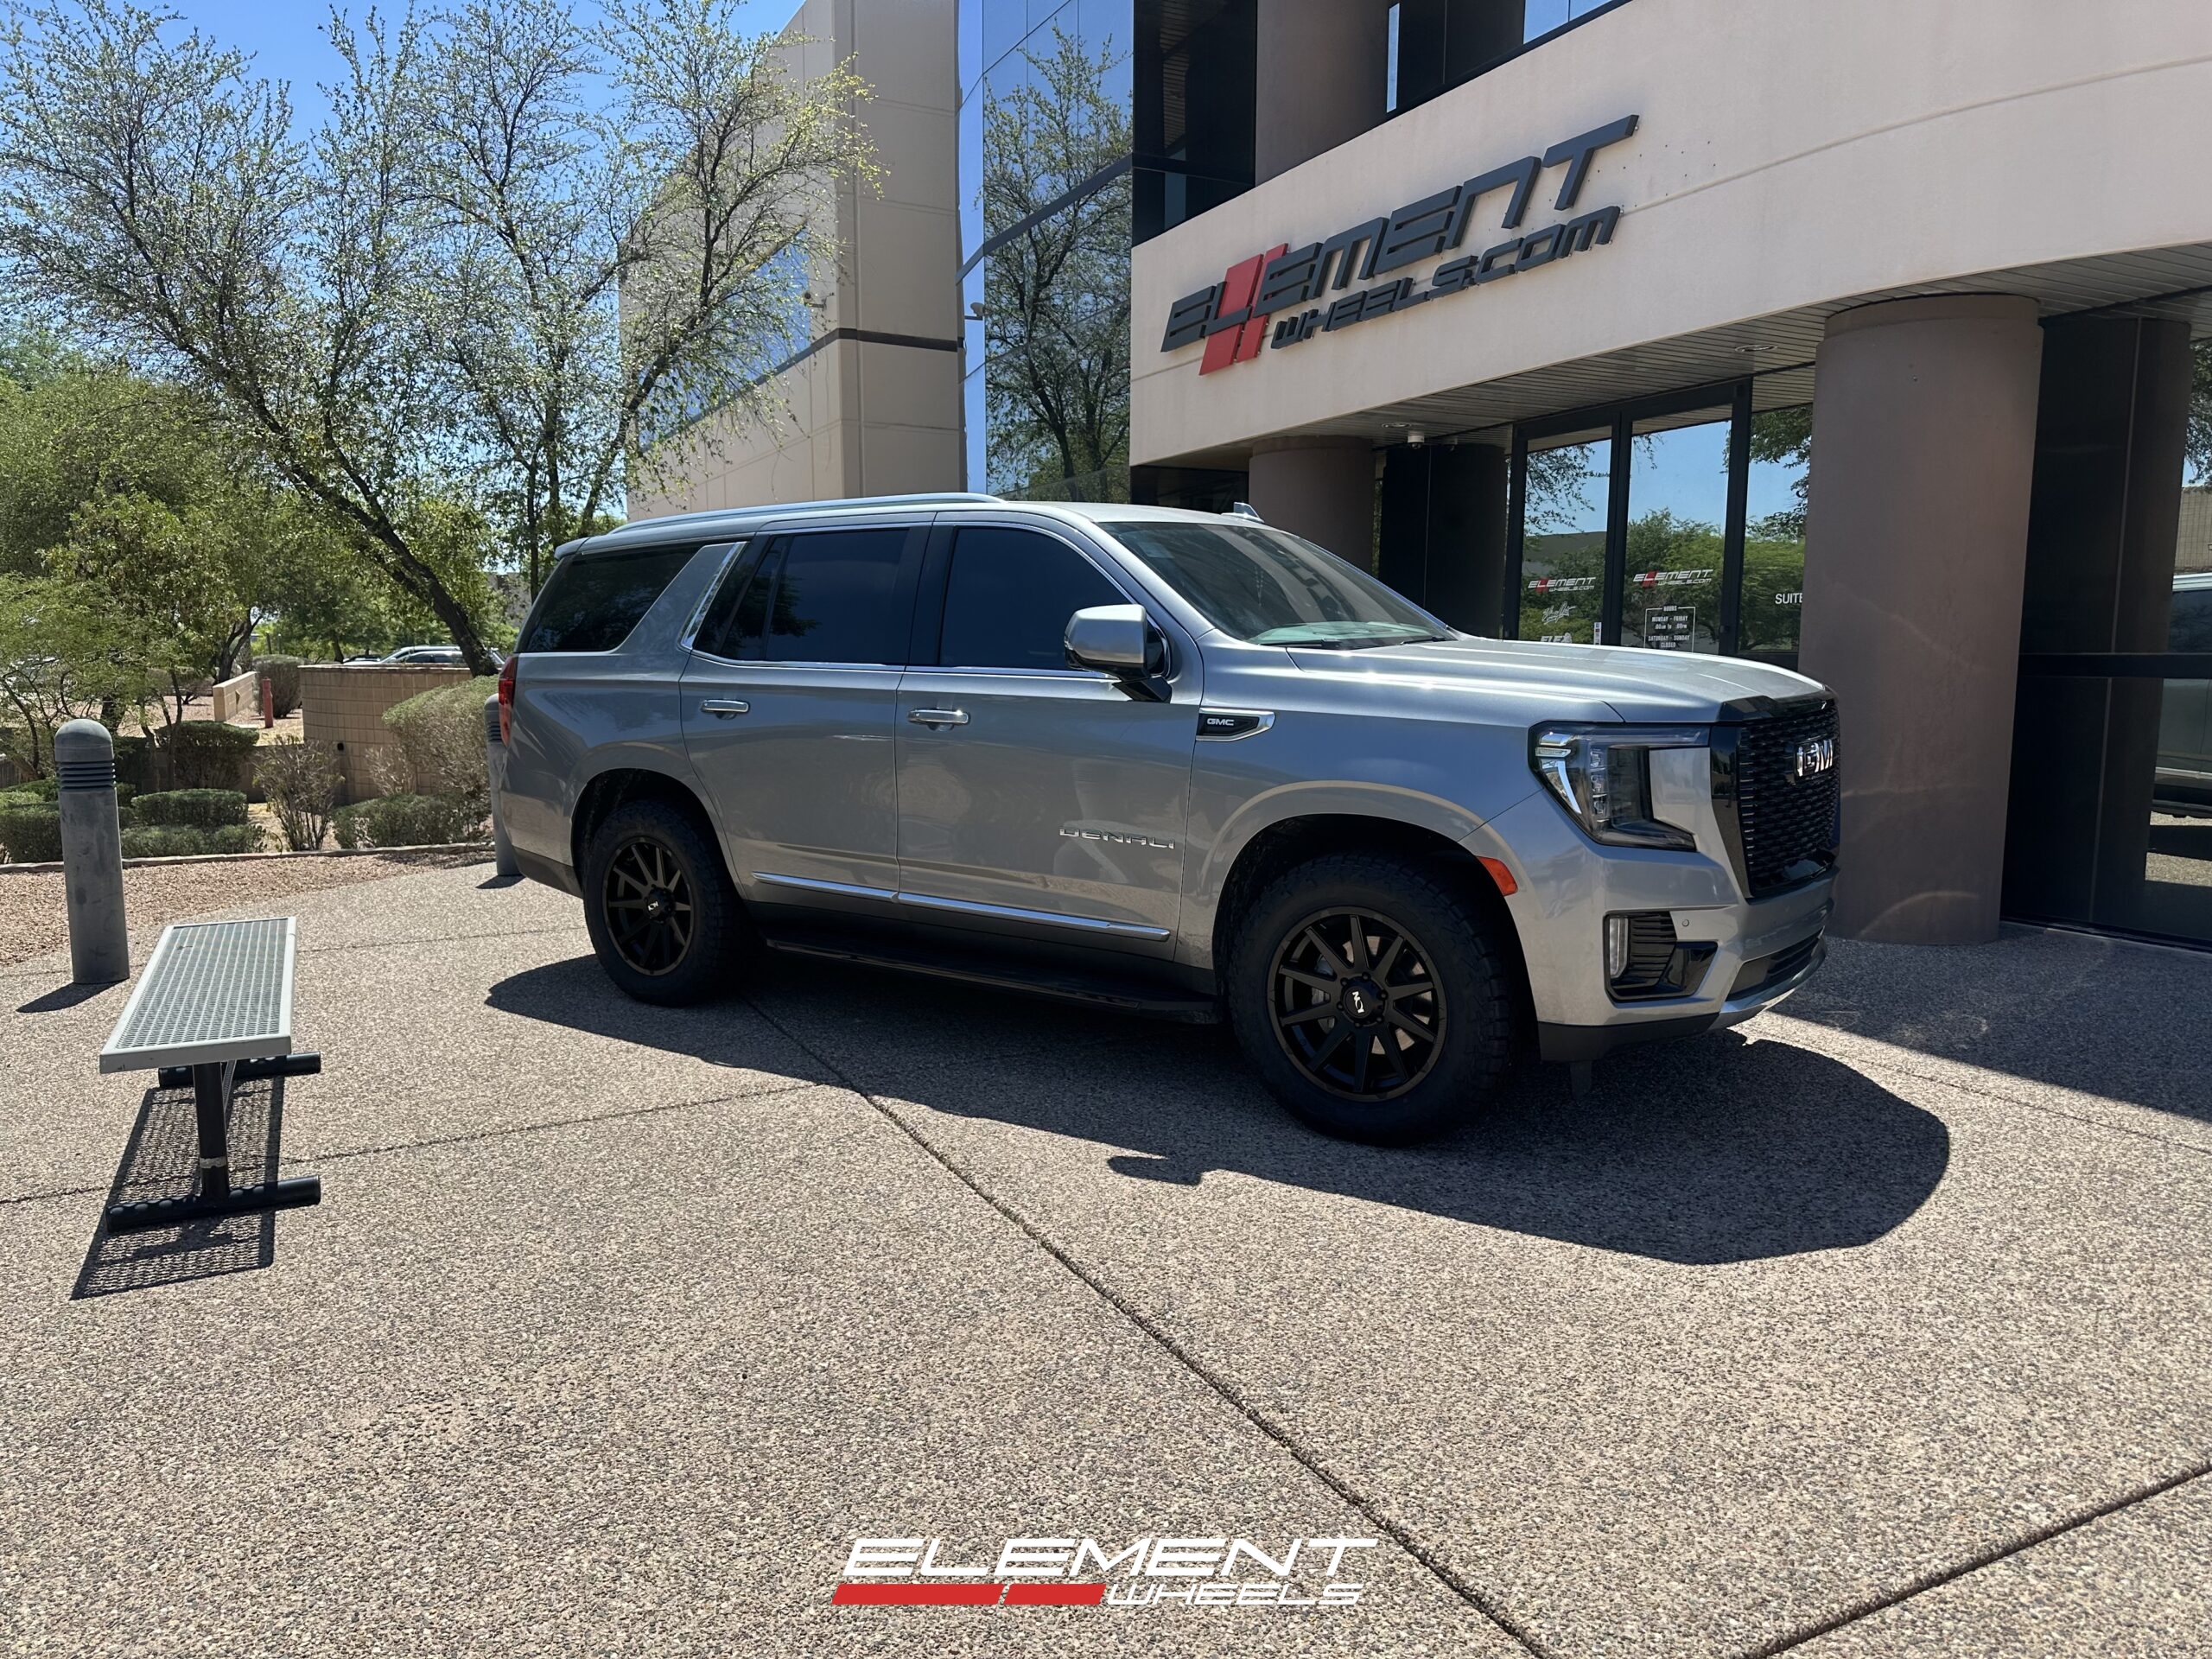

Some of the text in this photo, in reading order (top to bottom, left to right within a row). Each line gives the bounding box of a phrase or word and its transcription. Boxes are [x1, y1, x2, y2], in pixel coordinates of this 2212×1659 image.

[1161, 114, 1639, 353] ELEMENT
[1271, 206, 1621, 349] WHEELS.COM
[1528, 576, 1596, 588] ELEMENT
[1633, 569, 1713, 582] ELEMENT
[1207, 718, 1235, 727] GMC
[1059, 827, 1175, 849] DENALI
